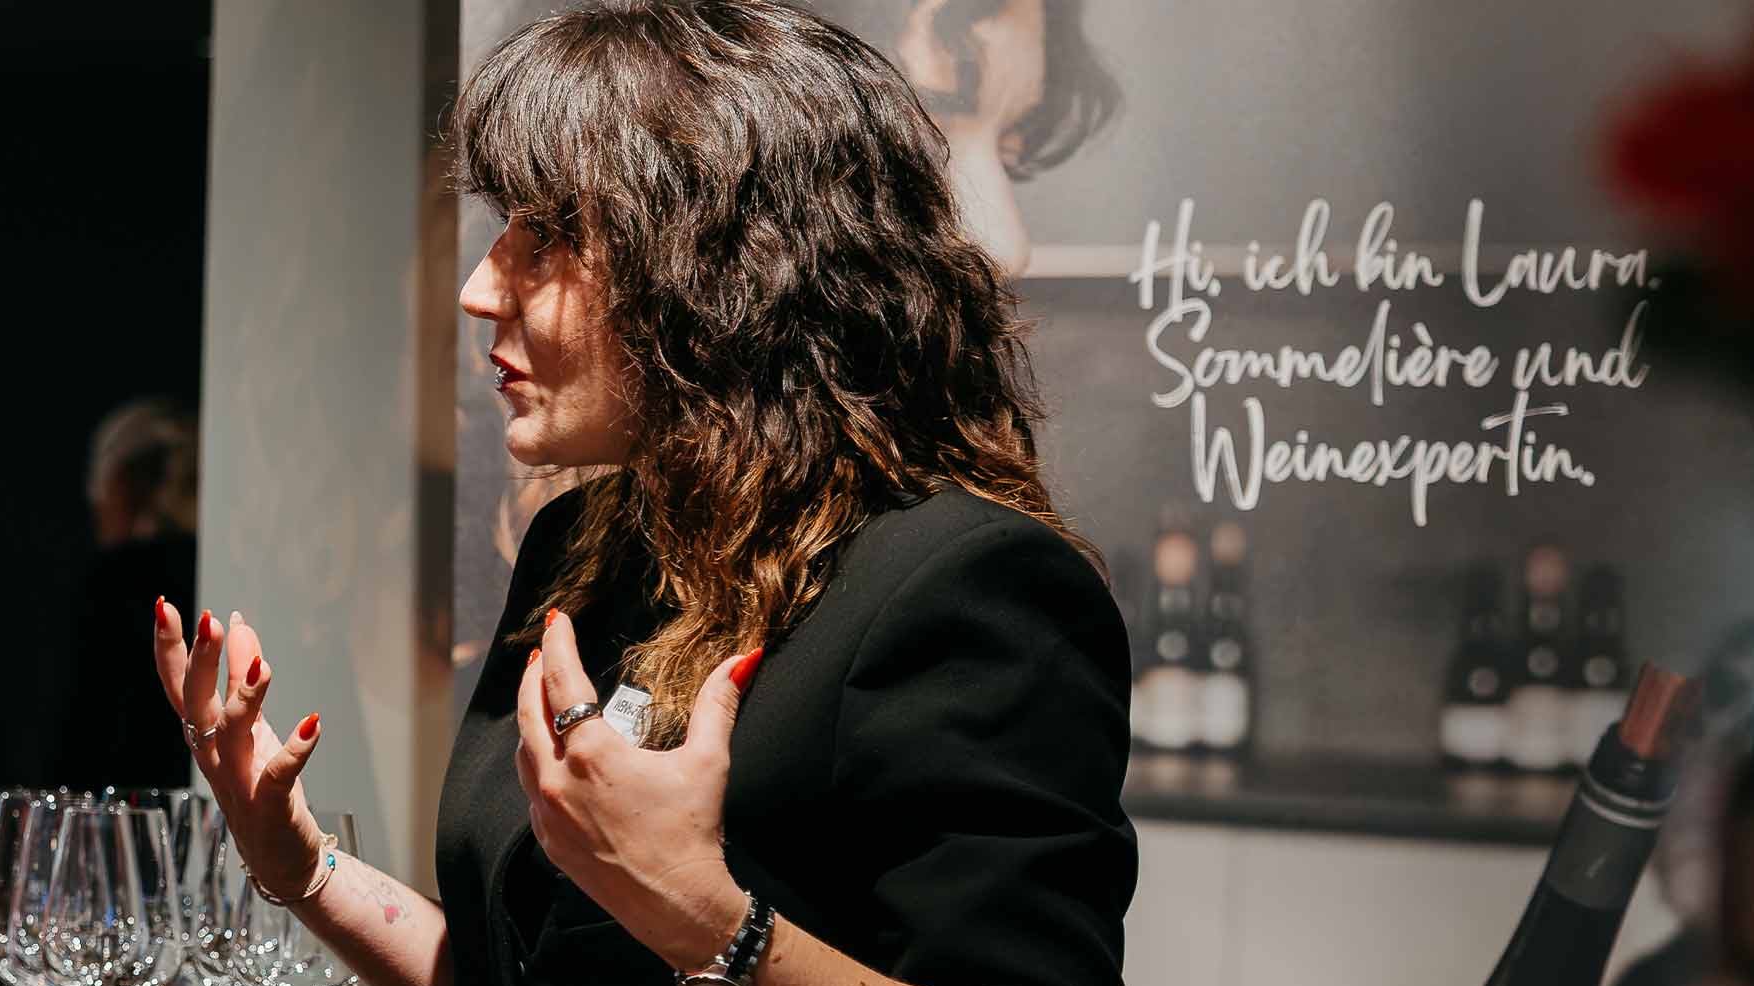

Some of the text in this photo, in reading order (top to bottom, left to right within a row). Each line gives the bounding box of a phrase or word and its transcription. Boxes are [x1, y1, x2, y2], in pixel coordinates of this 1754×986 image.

[1245, 198, 1339, 295] ich
[1354, 201, 1444, 293] bin
[1146, 297, 1651, 409] Sommelière und
[1191, 390, 1595, 527] Weinexpertin.
